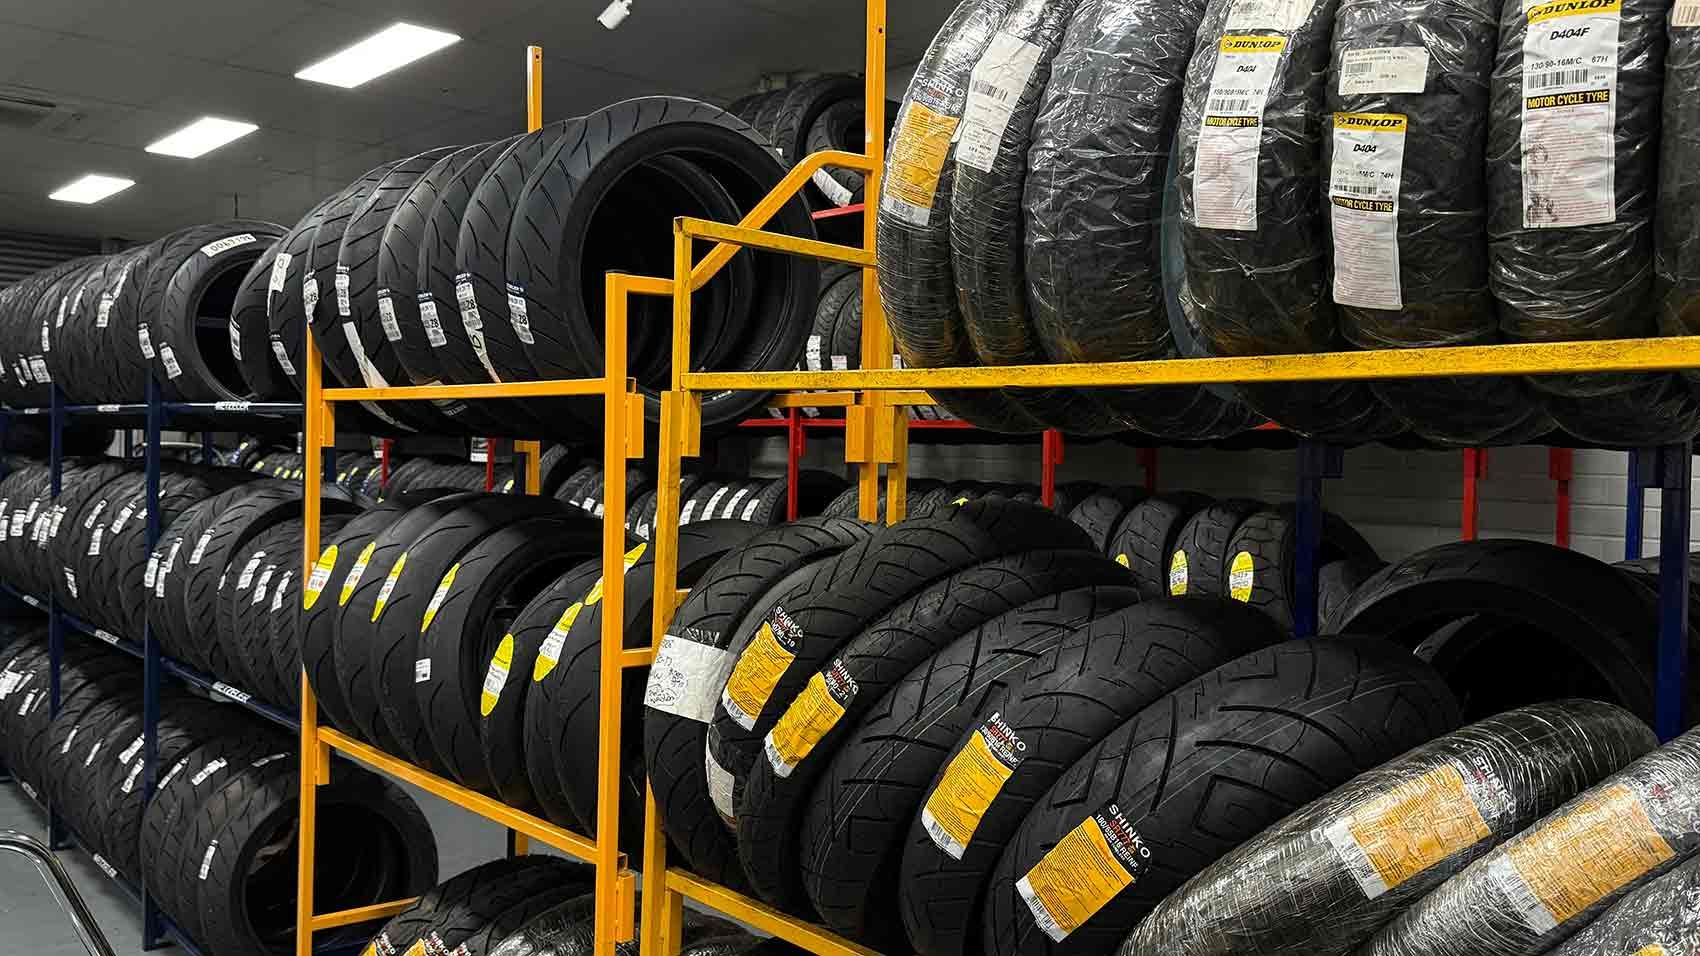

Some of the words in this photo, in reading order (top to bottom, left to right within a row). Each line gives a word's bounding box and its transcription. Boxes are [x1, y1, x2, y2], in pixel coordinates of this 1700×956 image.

[1543, 0, 1615, 15] DUNLOP
[1550, 27, 1590, 40] D404F
[1233, 40, 1281, 48] DUNLOP
[1591, 55, 1609, 63] 67H
[1527, 97, 1556, 109] MOTOR
[1557, 93, 1585, 105] CYCLE
[1586, 90, 1609, 102] TYRE
[1243, 117, 1258, 127] TYRE
[1347, 117, 1403, 127] DUNLOP
[1353, 143, 1377, 153] D404
[1353, 199, 1374, 210] CYCLE
[1375, 201, 1393, 211] TYRE
[775, 606, 804, 638] SHINKO
[833, 658, 859, 696] SHINKO
[989, 711, 1027, 752] SHINKO
[1473, 755, 1517, 815] SHINKO
[1109, 803, 1151, 858] SHINKO
